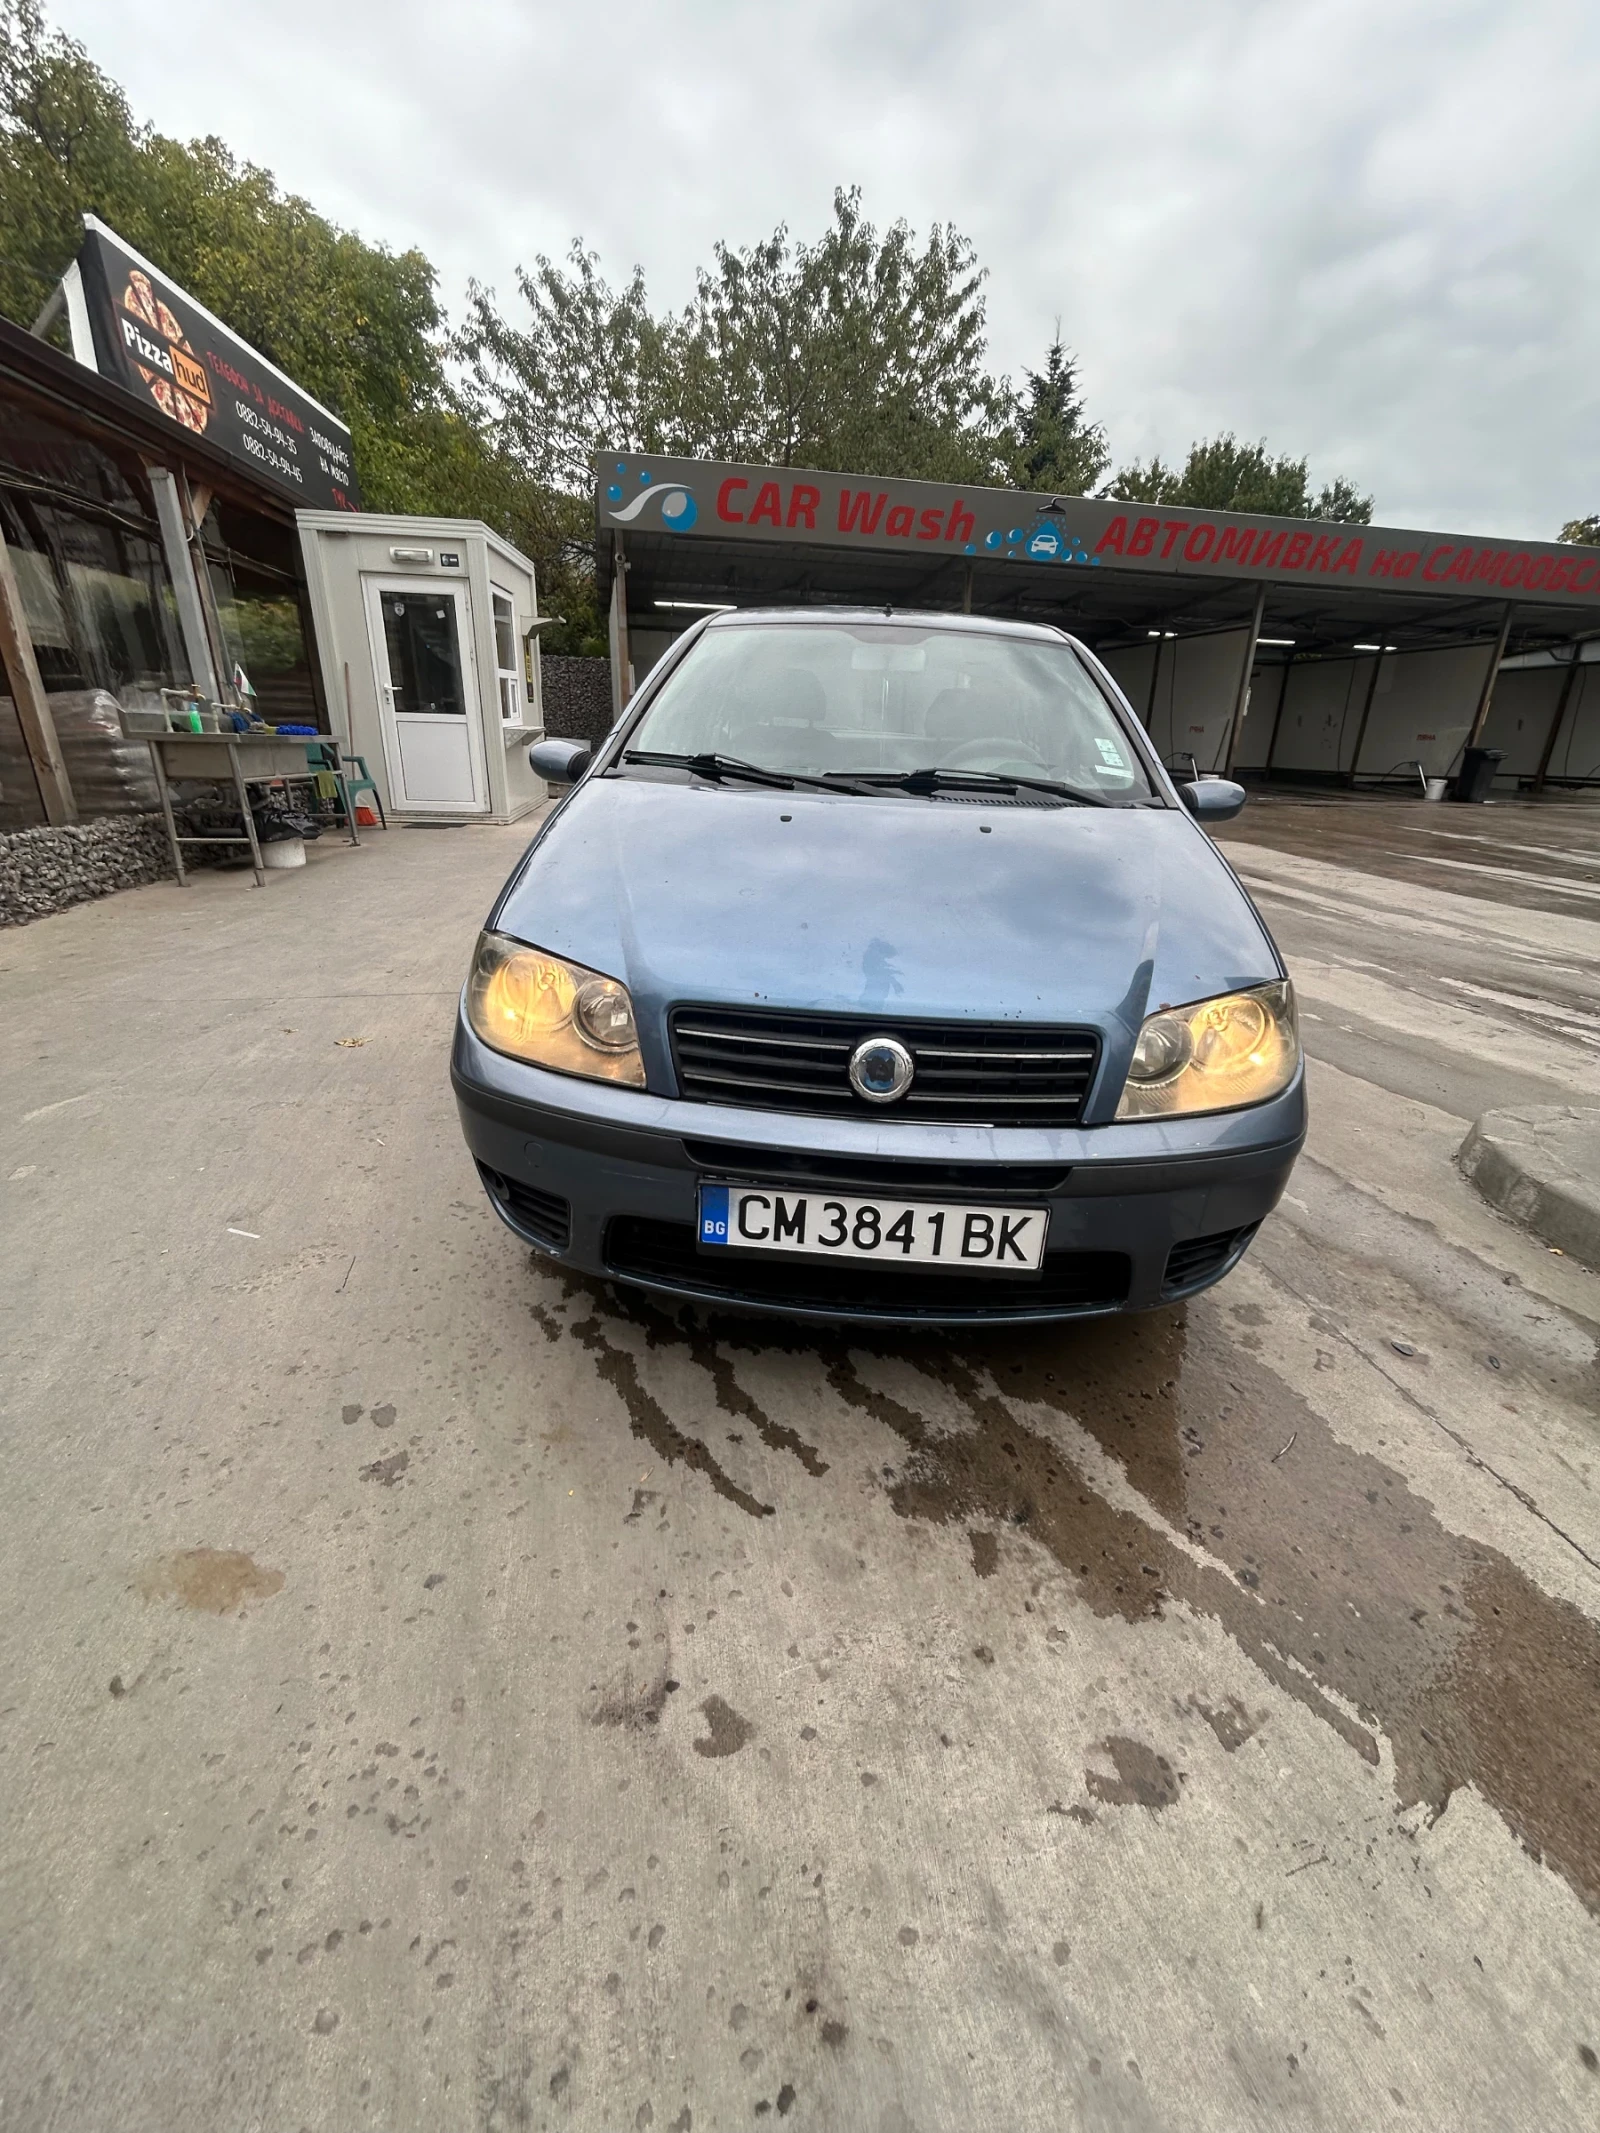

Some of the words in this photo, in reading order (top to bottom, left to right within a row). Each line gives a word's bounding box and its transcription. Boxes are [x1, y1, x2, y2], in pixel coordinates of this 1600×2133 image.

[121, 317, 174, 375] Pizza
[173, 353, 207, 396] hud
[235, 400, 297, 455] 0882-54-94-35
[243, 433, 303, 484] 0882-54-94-45
[716, 477, 821, 530] CAR
[837, 489, 976, 543] Wash
[1094, 515, 1365, 575] АВТОМИВКА
[1368, 548, 1422, 580] на
[1421, 545, 1600, 595] САМООБС
[704, 1219, 726, 1235] BG
[738, 1194, 807, 1245] CM
[817, 1201, 946, 1257] 3841
[960, 1213, 1033, 1262] BK
